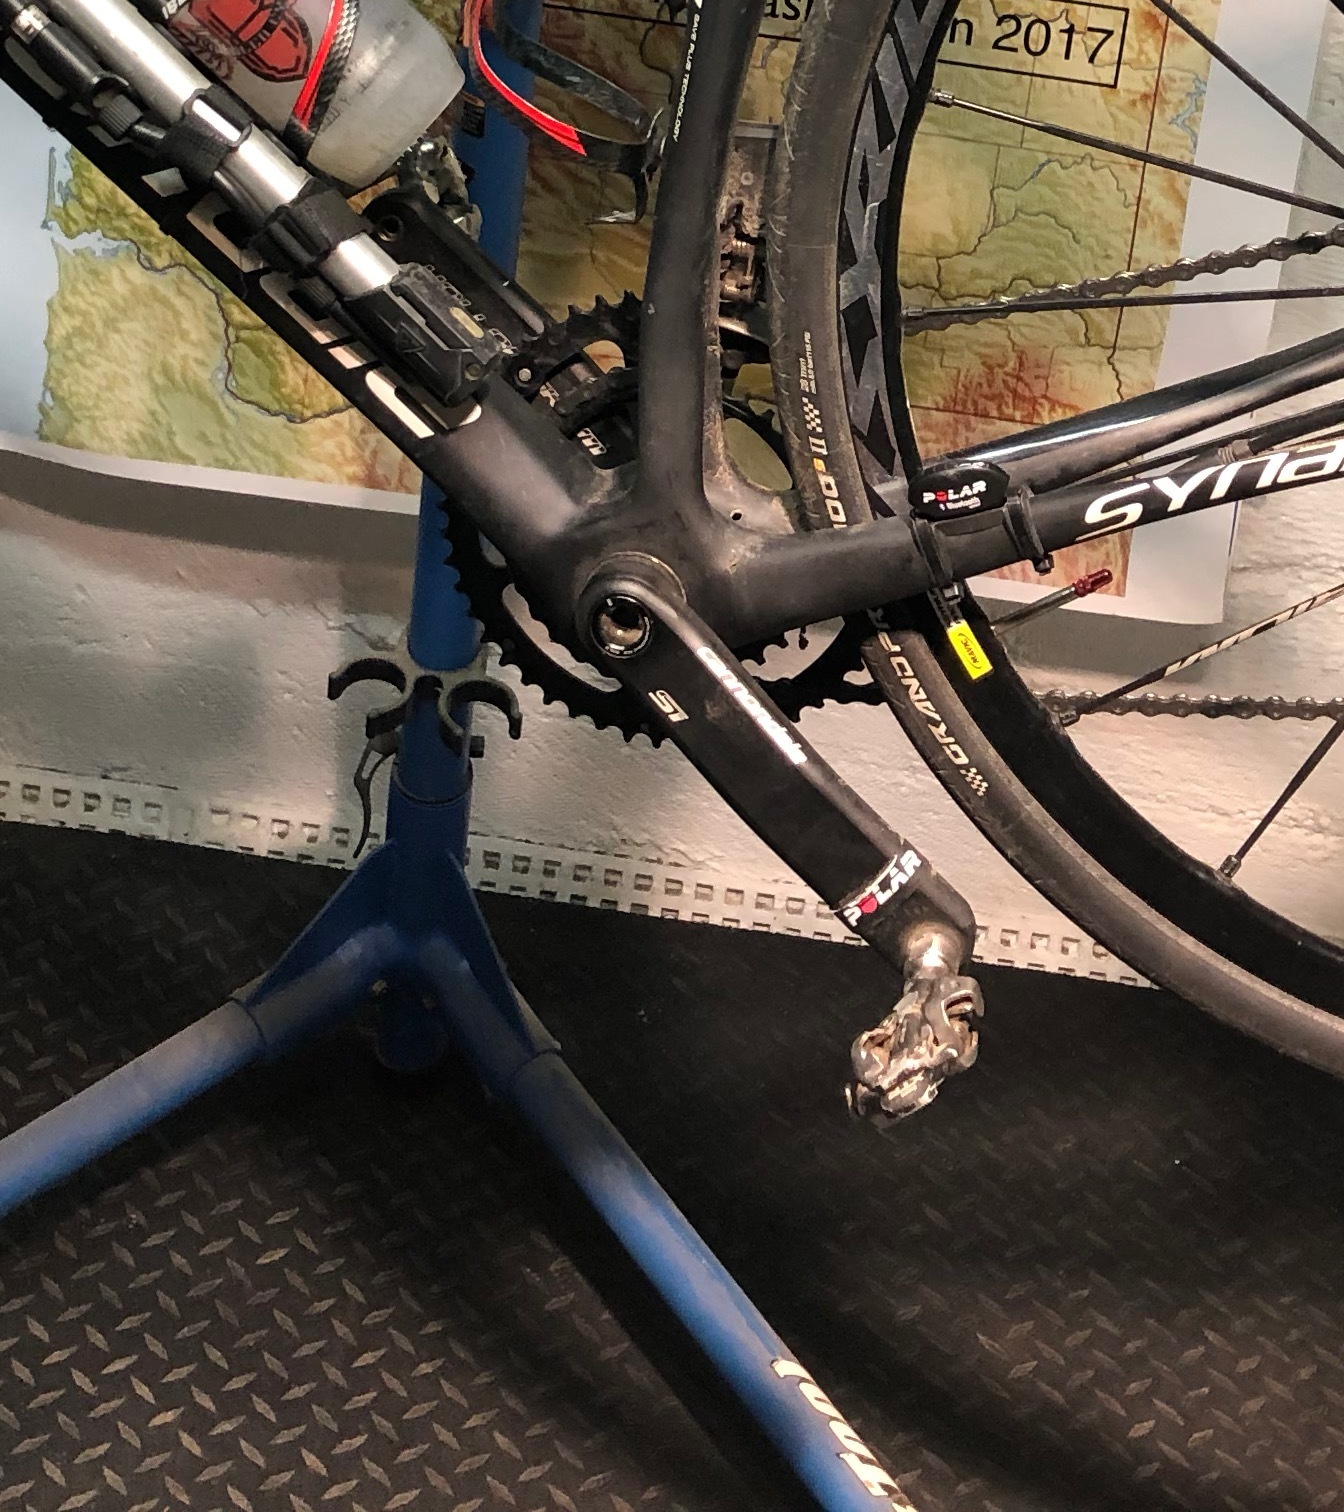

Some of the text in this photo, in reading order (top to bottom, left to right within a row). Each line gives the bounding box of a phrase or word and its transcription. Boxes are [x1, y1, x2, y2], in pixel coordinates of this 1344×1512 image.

[991, 10, 1115, 65] 2017
[673, 13, 701, 143] SAVE PLUS TECHNOLOGY
[922, 479, 987, 504] POLAR
[892, 659, 970, 767] GRAND
[842, 848, 923, 928] POLAR
